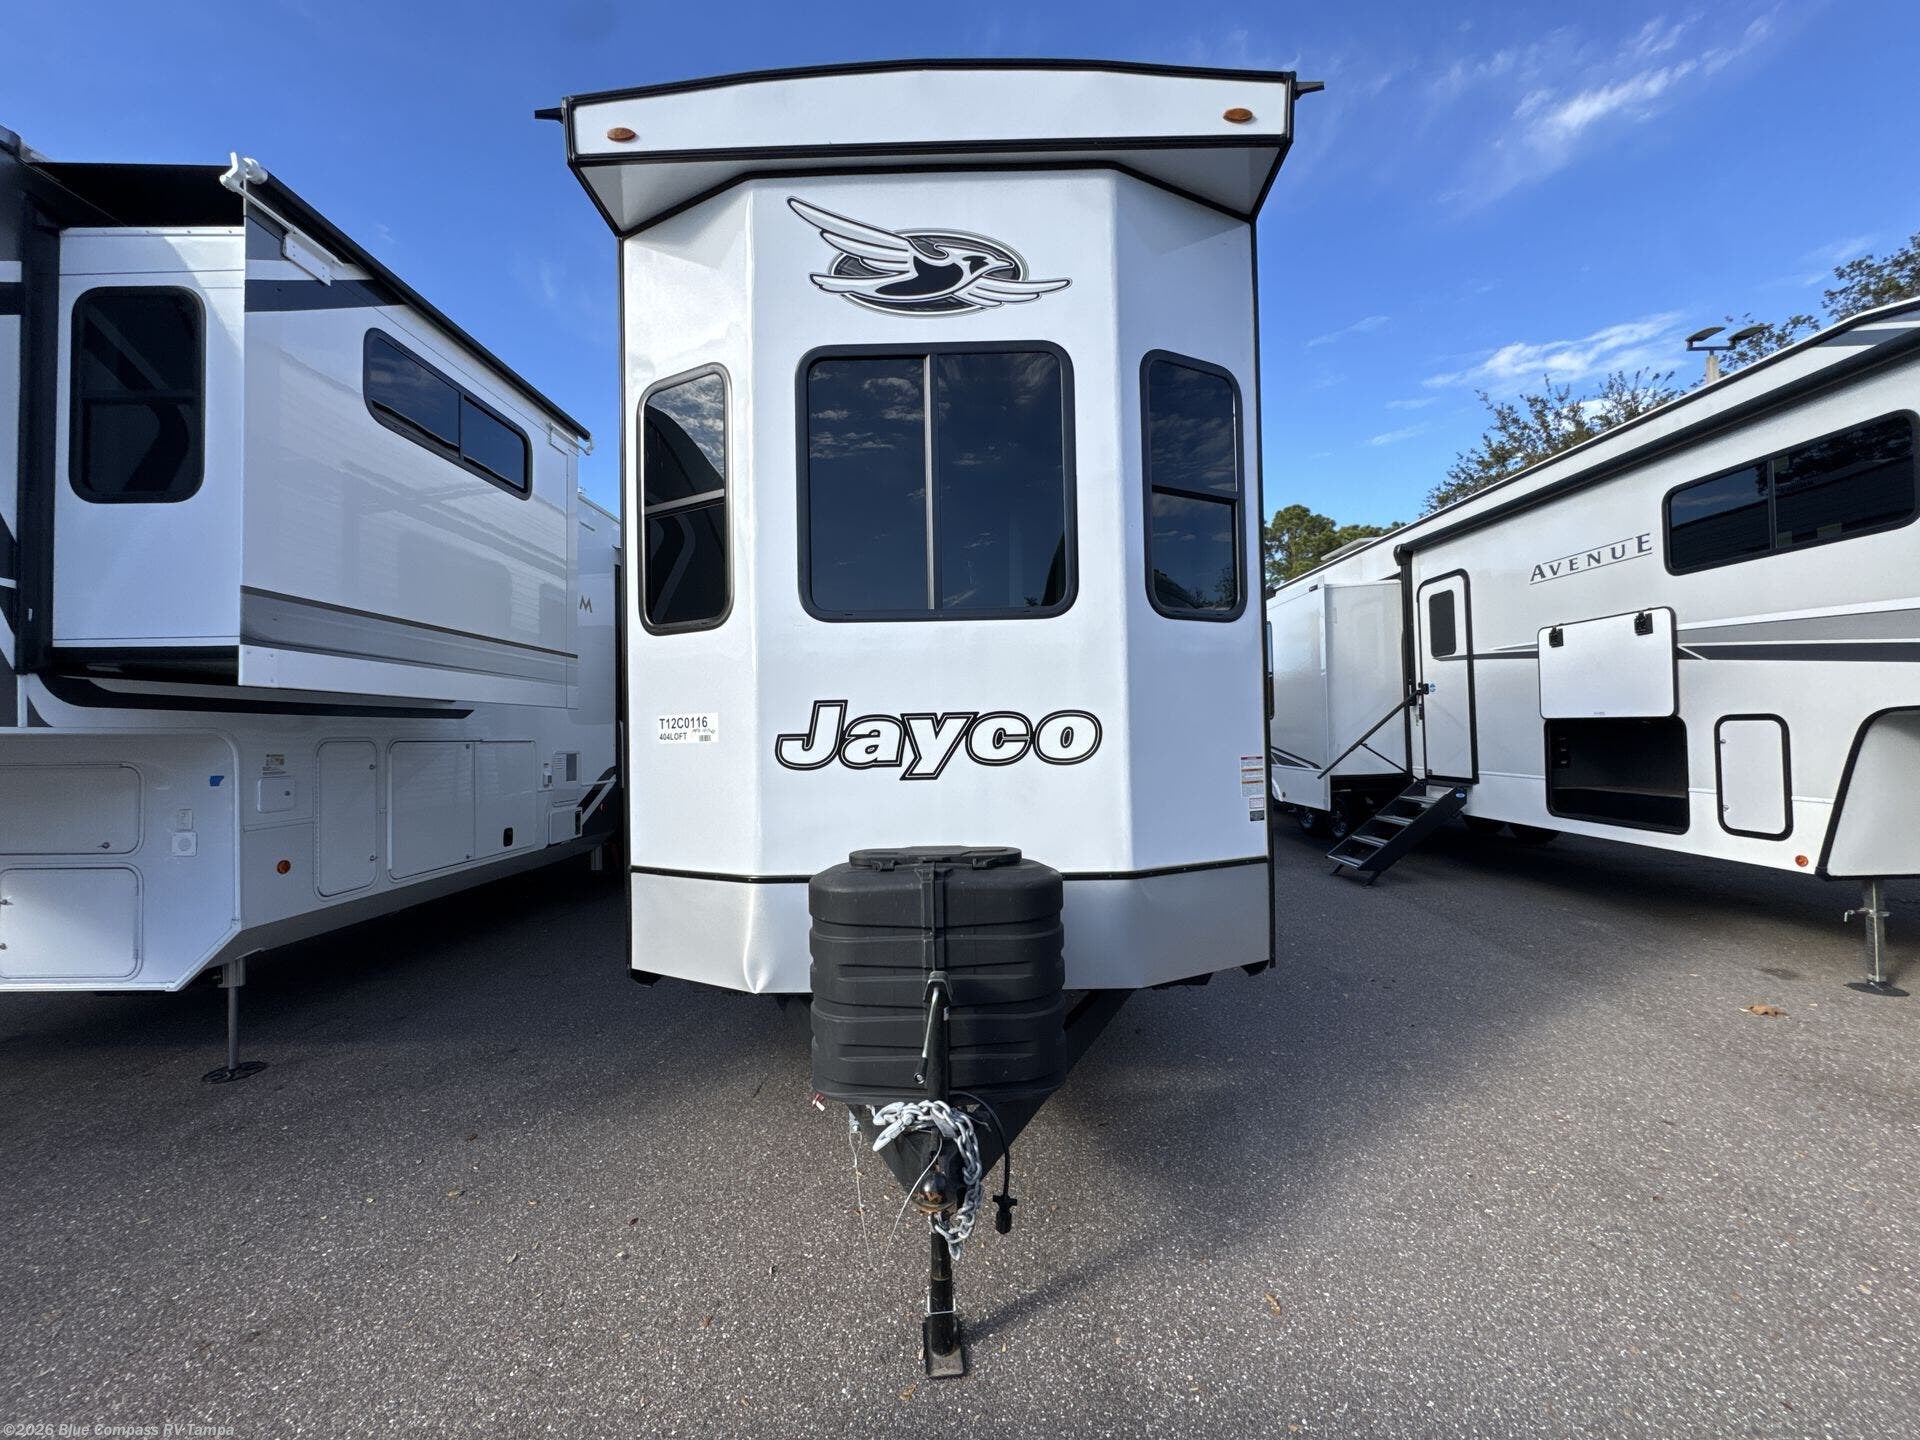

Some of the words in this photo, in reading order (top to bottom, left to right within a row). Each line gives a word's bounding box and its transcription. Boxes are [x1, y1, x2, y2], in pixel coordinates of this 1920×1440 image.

[1530, 533, 1652, 582] AVENUE
[659, 716, 708, 729] T12C0116
[659, 732, 687, 741] 404LOFT
[775, 700, 1103, 781] Jayco
